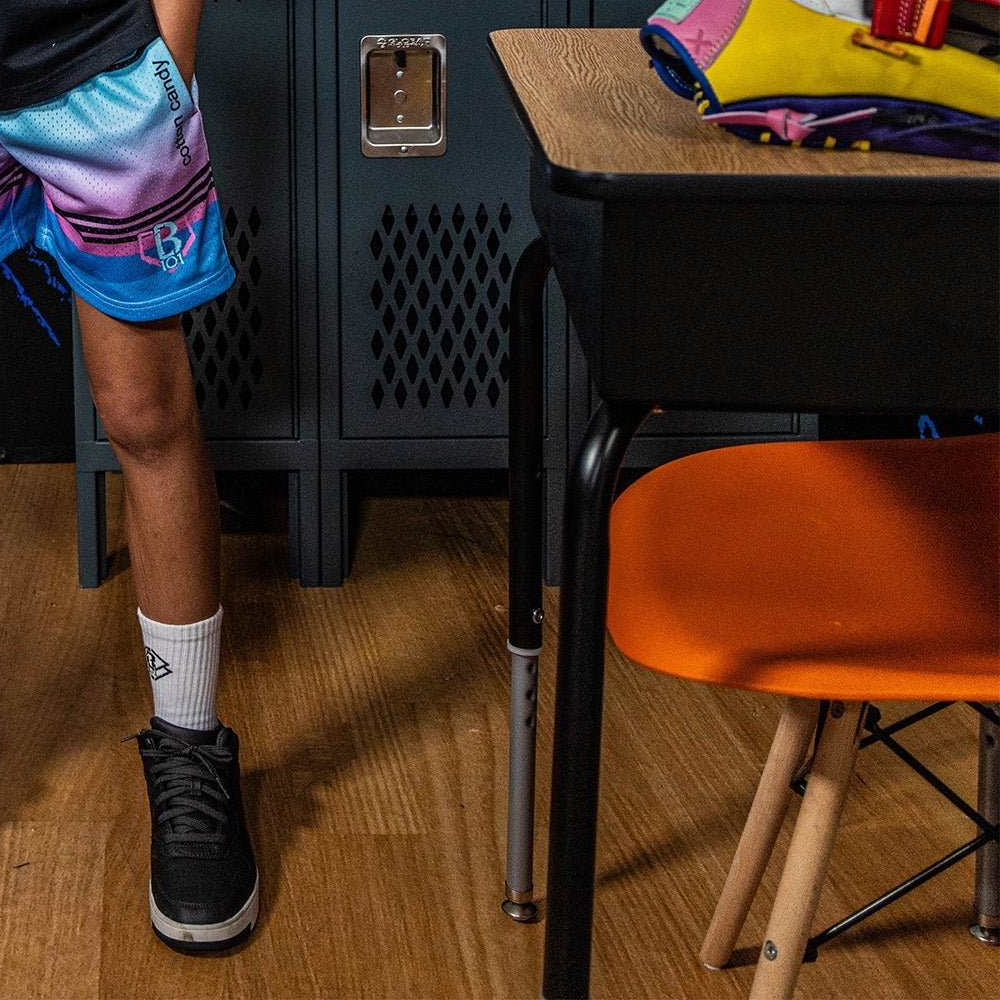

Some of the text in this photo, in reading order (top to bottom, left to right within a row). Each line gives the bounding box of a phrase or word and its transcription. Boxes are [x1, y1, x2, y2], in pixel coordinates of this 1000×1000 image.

[152, 60, 191, 167] cotton candy
[153, 221, 182, 259] B
[159, 253, 185, 272] 101
